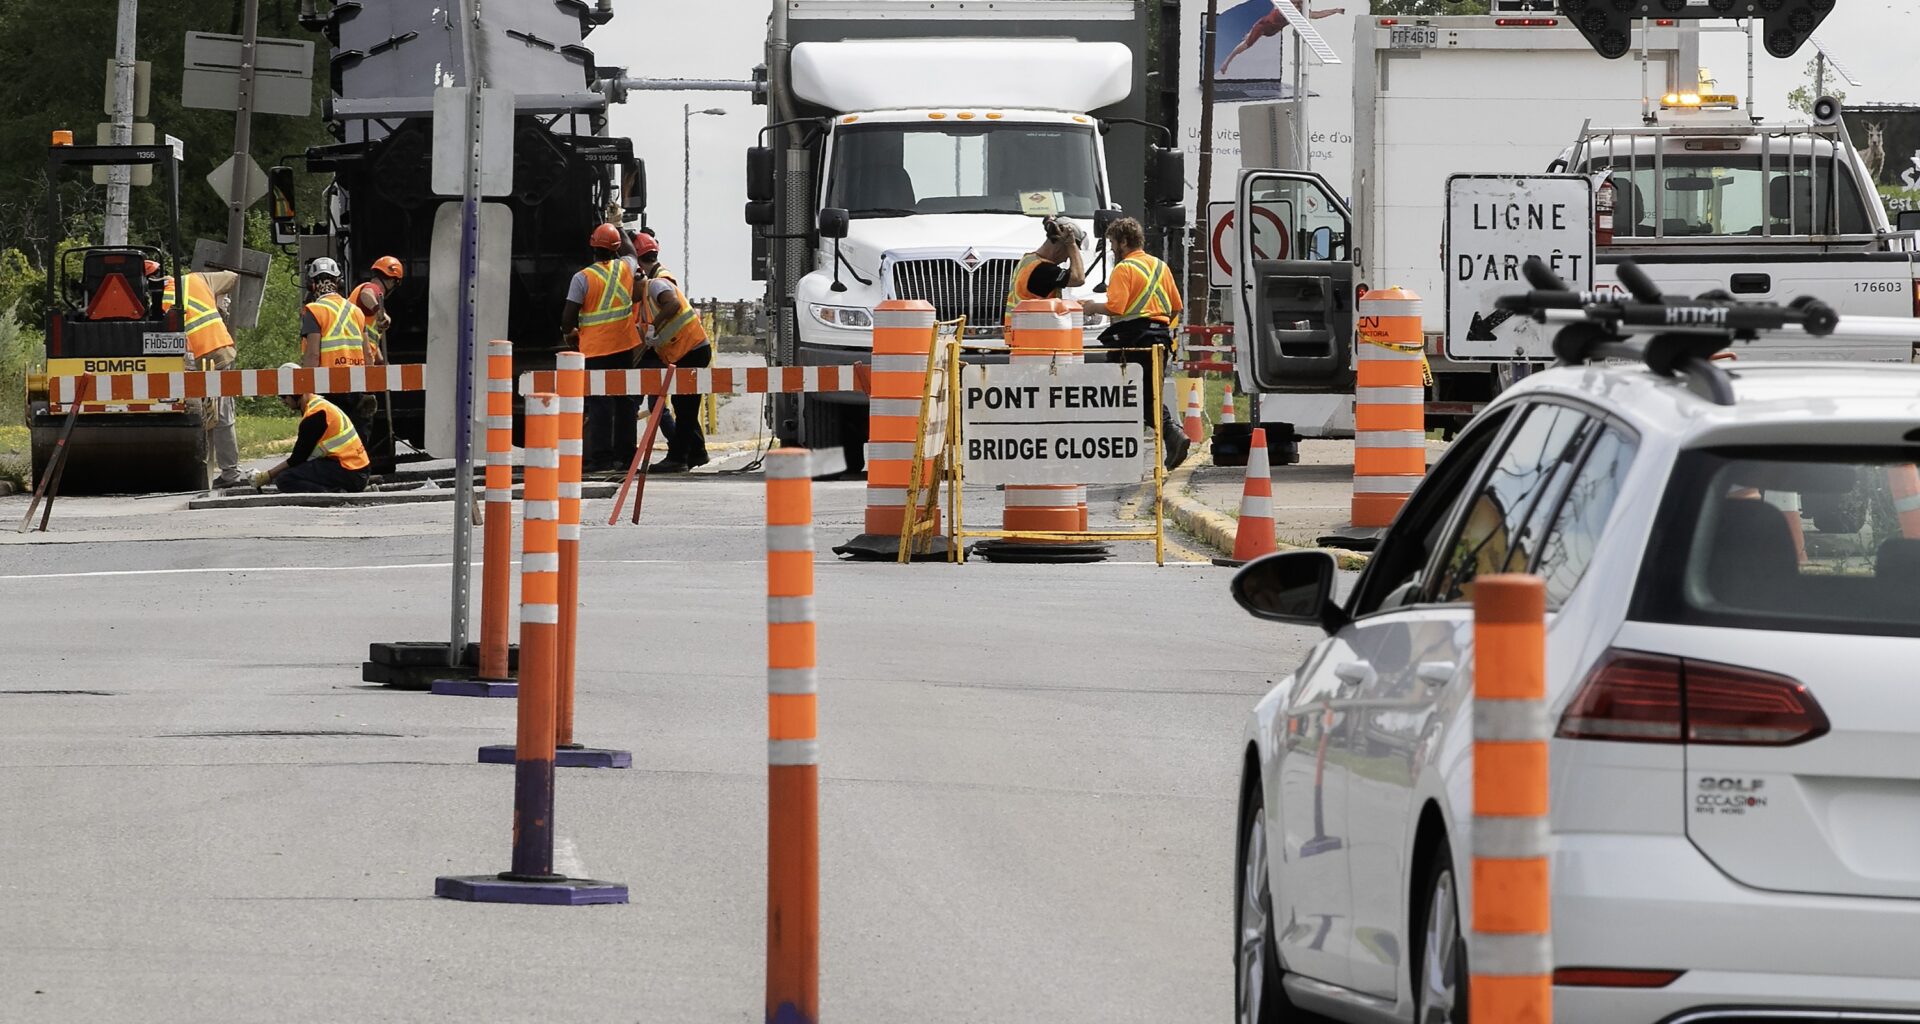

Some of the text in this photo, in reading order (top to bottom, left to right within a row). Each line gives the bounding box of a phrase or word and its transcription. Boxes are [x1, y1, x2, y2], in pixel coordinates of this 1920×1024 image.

[1392, 31, 1436, 44] FFF4619
[1473, 203, 1566, 231] LIGNE
[1458, 249, 1582, 281] D'ARÊT
[1854, 282, 1902, 293] 176603
[1359, 315, 1379, 328] CN
[1665, 306, 1730, 323] HTTMT
[84, 360, 146, 373] BOMAG
[967, 380, 1138, 410] PONT FERMÉ
[968, 437, 1138, 460] BRIDGE CLOSED
[1699, 777, 1764, 791] GOLF
